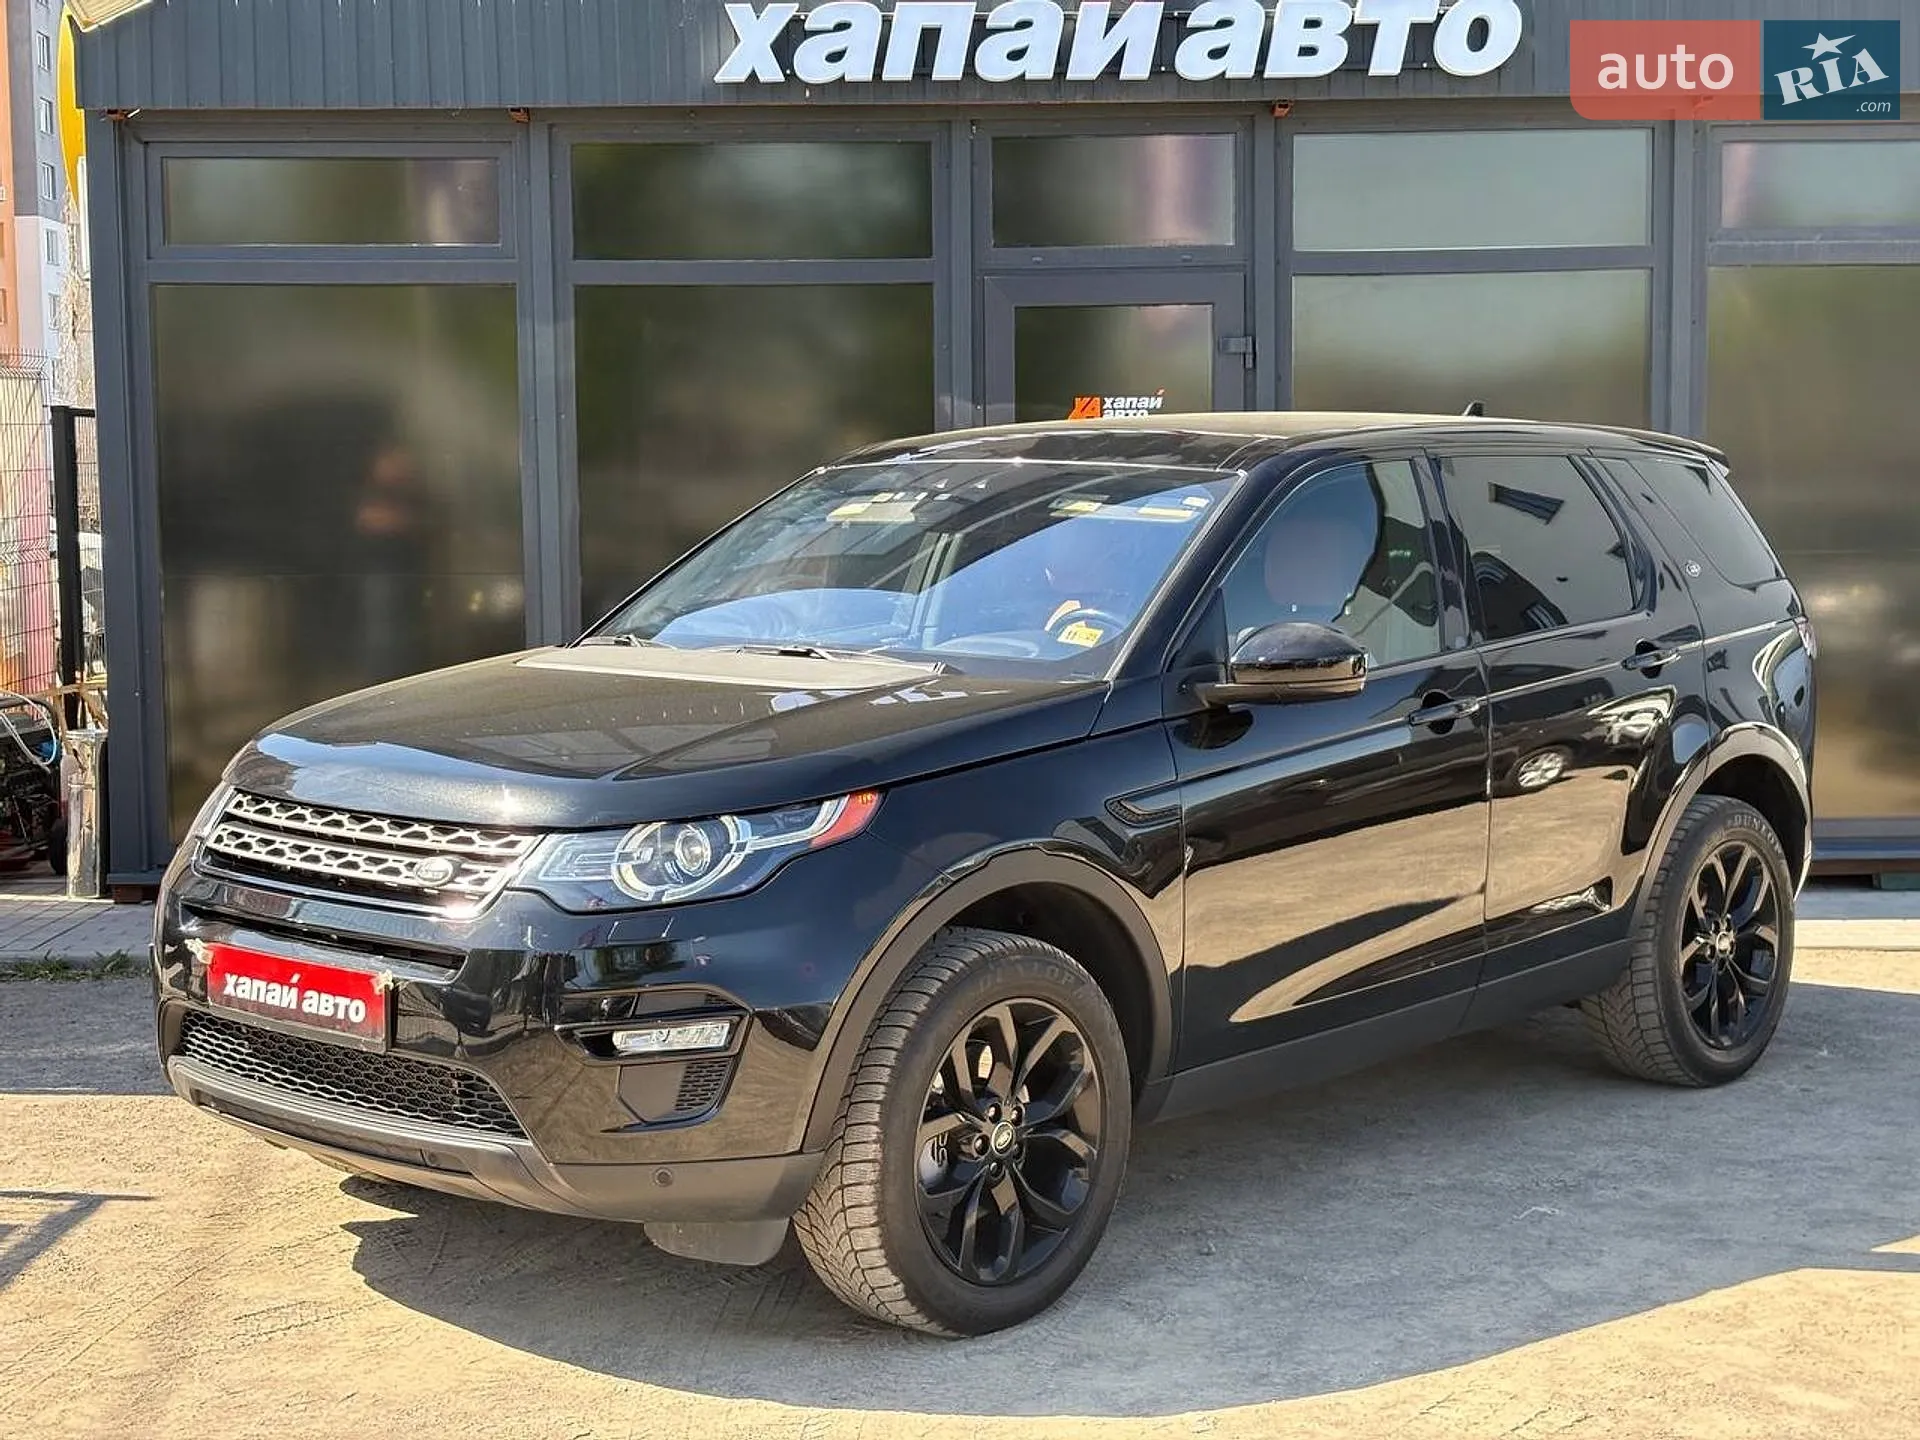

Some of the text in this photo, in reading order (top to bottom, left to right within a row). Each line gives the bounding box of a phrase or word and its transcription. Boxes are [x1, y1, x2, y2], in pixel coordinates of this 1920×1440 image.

[1174, 0, 1524, 80] авто
[222, 972, 367, 1024] хапай авто
